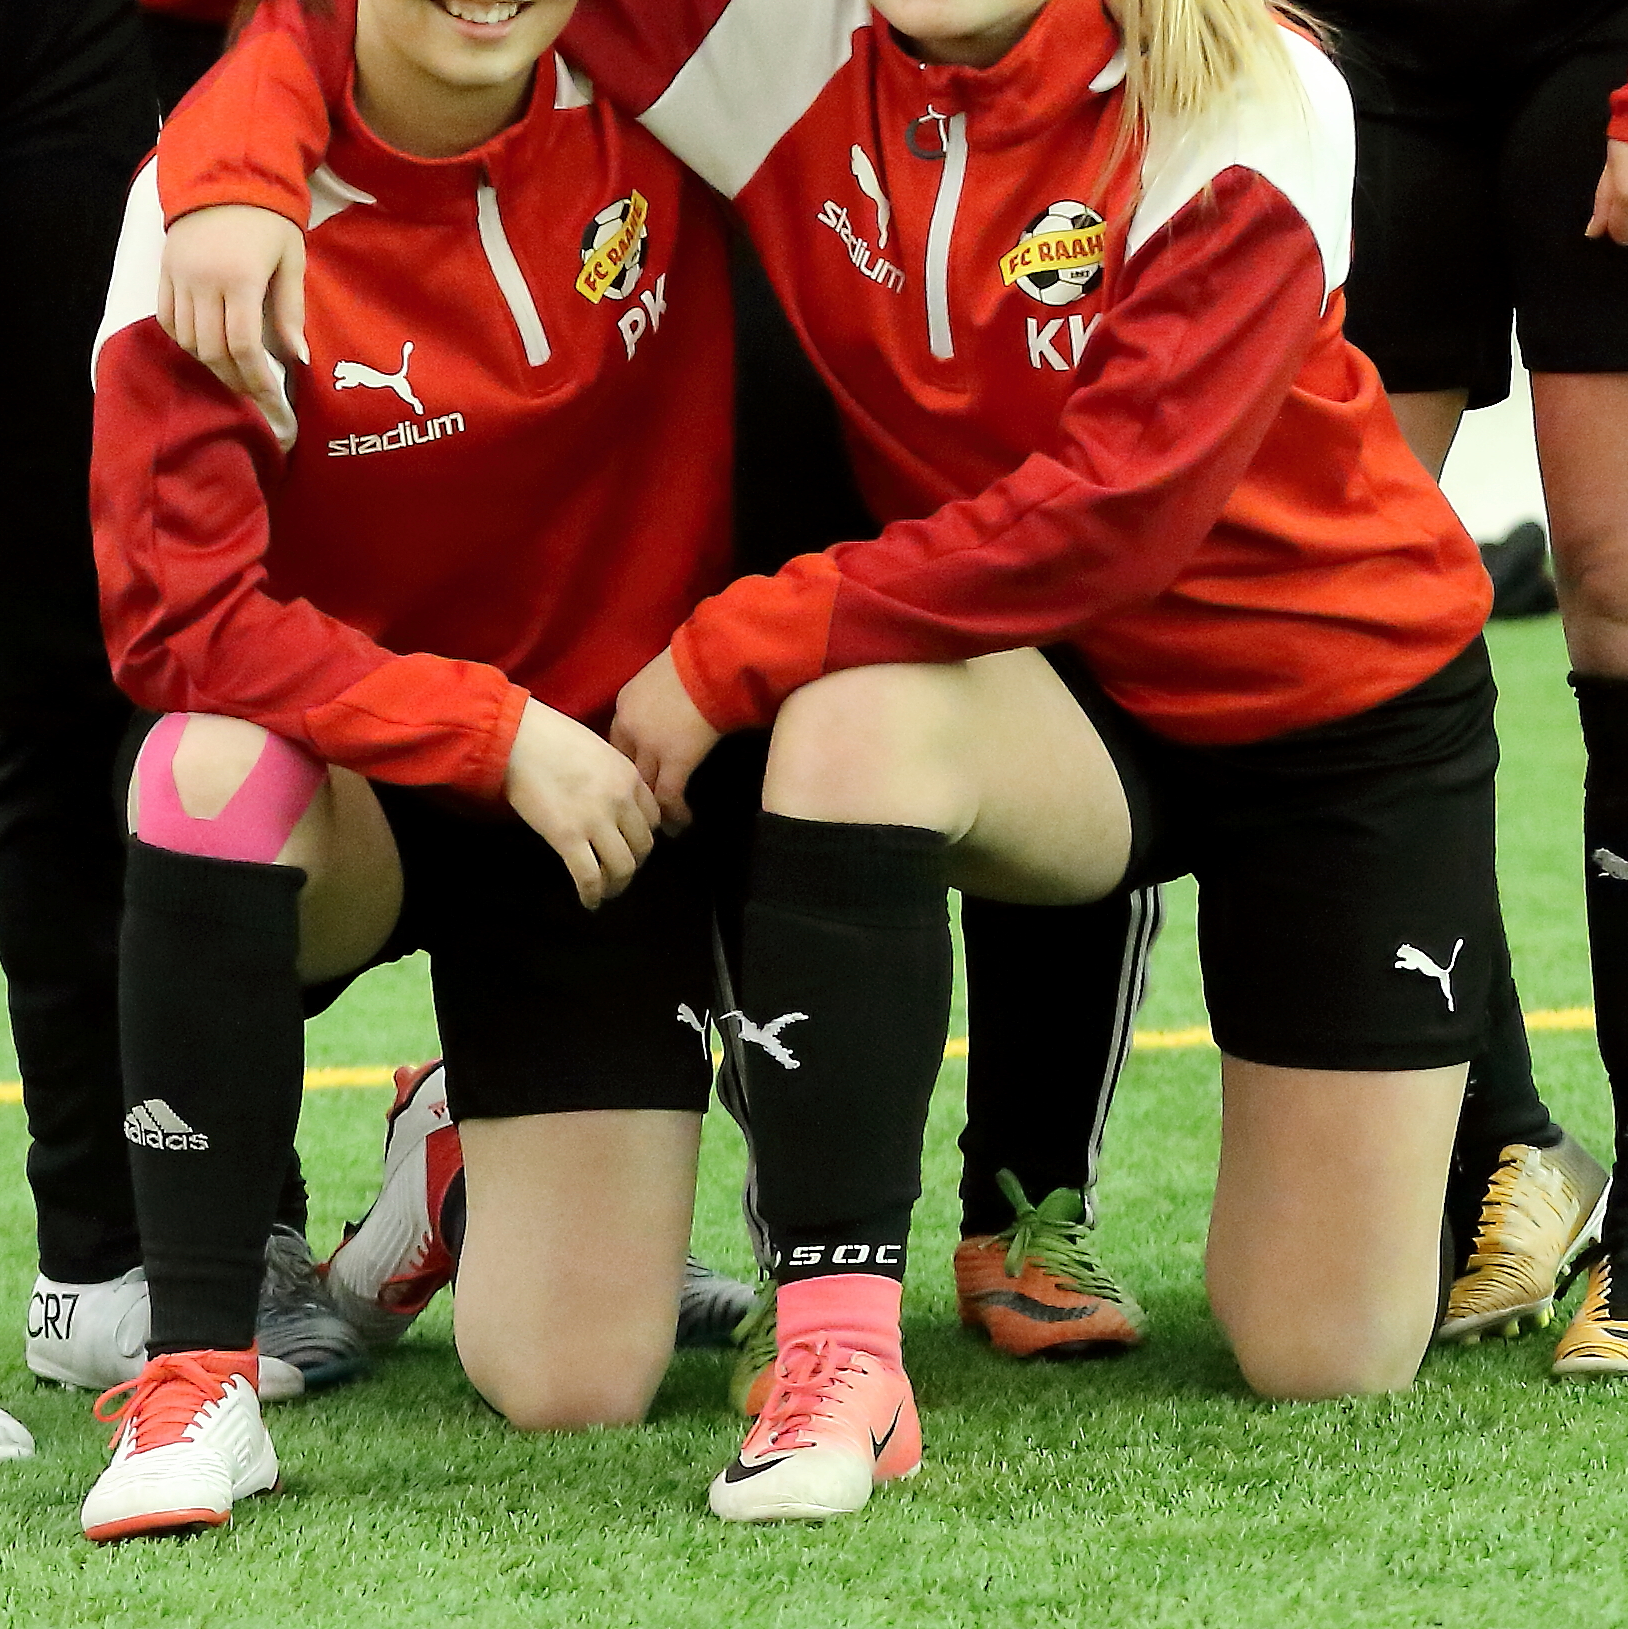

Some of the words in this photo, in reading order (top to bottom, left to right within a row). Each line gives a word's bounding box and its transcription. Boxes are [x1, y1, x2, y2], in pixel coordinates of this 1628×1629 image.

[1008, 246, 1033, 275] FC
[1037, 230, 1106, 263] RAAH
[584, 260, 609, 292] FC
[617, 272, 667, 362] PK
[328, 411, 466, 457] stadium
[788, 1244, 903, 1266] SOC
[27, 1290, 81, 1340] CR7
